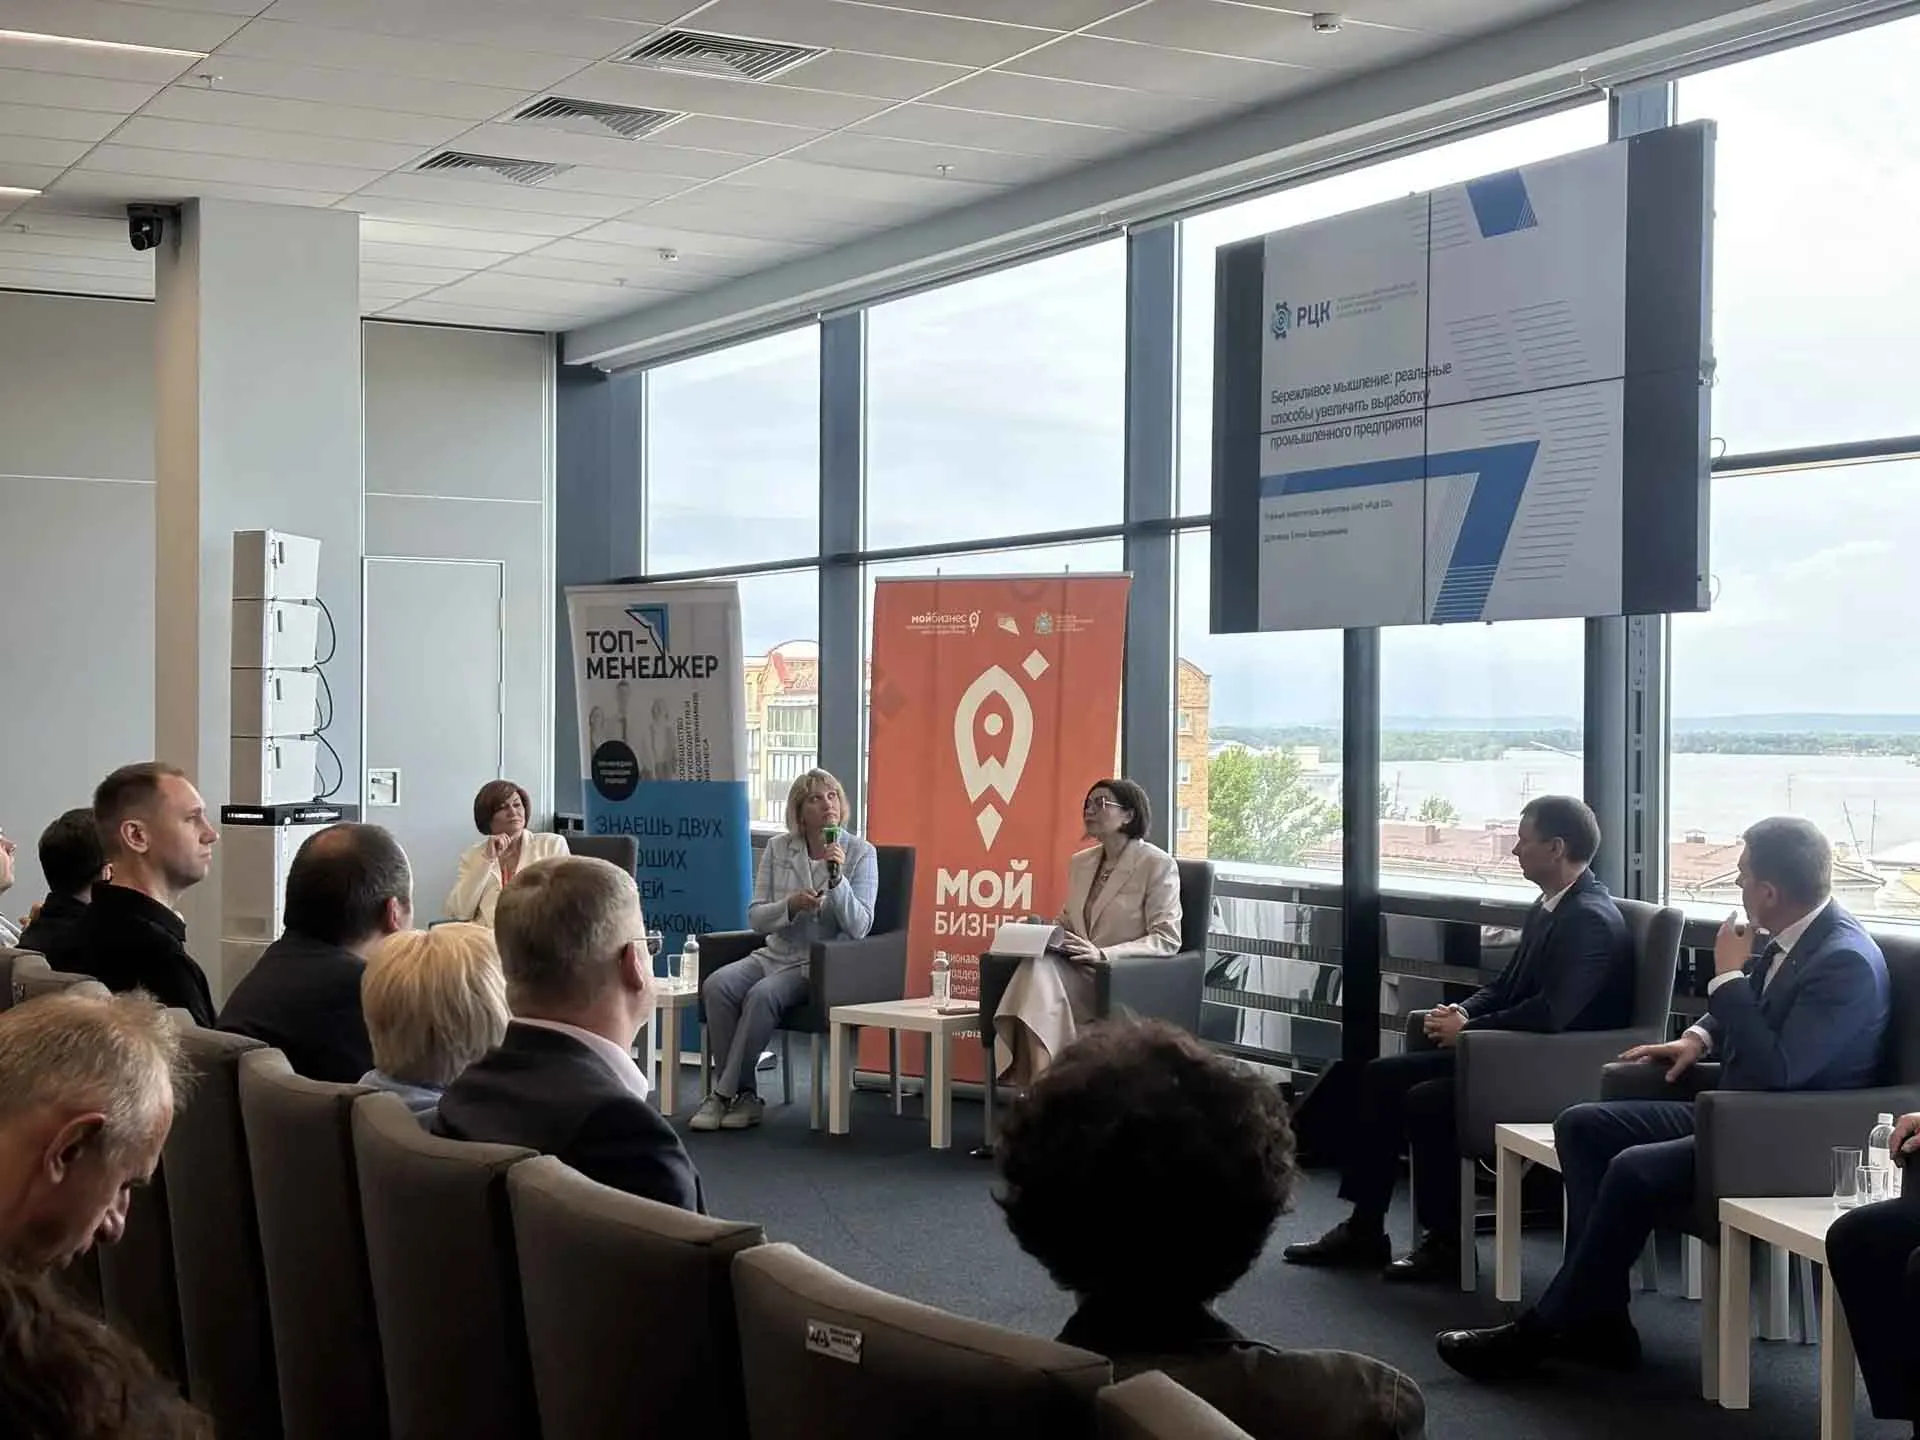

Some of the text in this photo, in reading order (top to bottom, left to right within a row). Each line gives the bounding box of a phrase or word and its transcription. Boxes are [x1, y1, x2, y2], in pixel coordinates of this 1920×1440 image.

[1297, 301, 1330, 328] РЦК
[1271, 362, 1452, 406] Бережливое мышление: реальные
[1271, 388, 1431, 426] способы увеличить выработку
[1270, 413, 1424, 450] промышленного предприятия
[586, 630, 648, 654] ТОП-
[586, 655, 719, 679] МЕНЕДЖЕР
[596, 814, 723, 839] ЗНАЕШЬ ДВУХ
[637, 848, 687, 870] ОШИХ
[638, 877, 665, 899] ЕЙ
[936, 859, 1033, 910] МОЙ
[643, 911, 713, 933] НАКОМЬ
